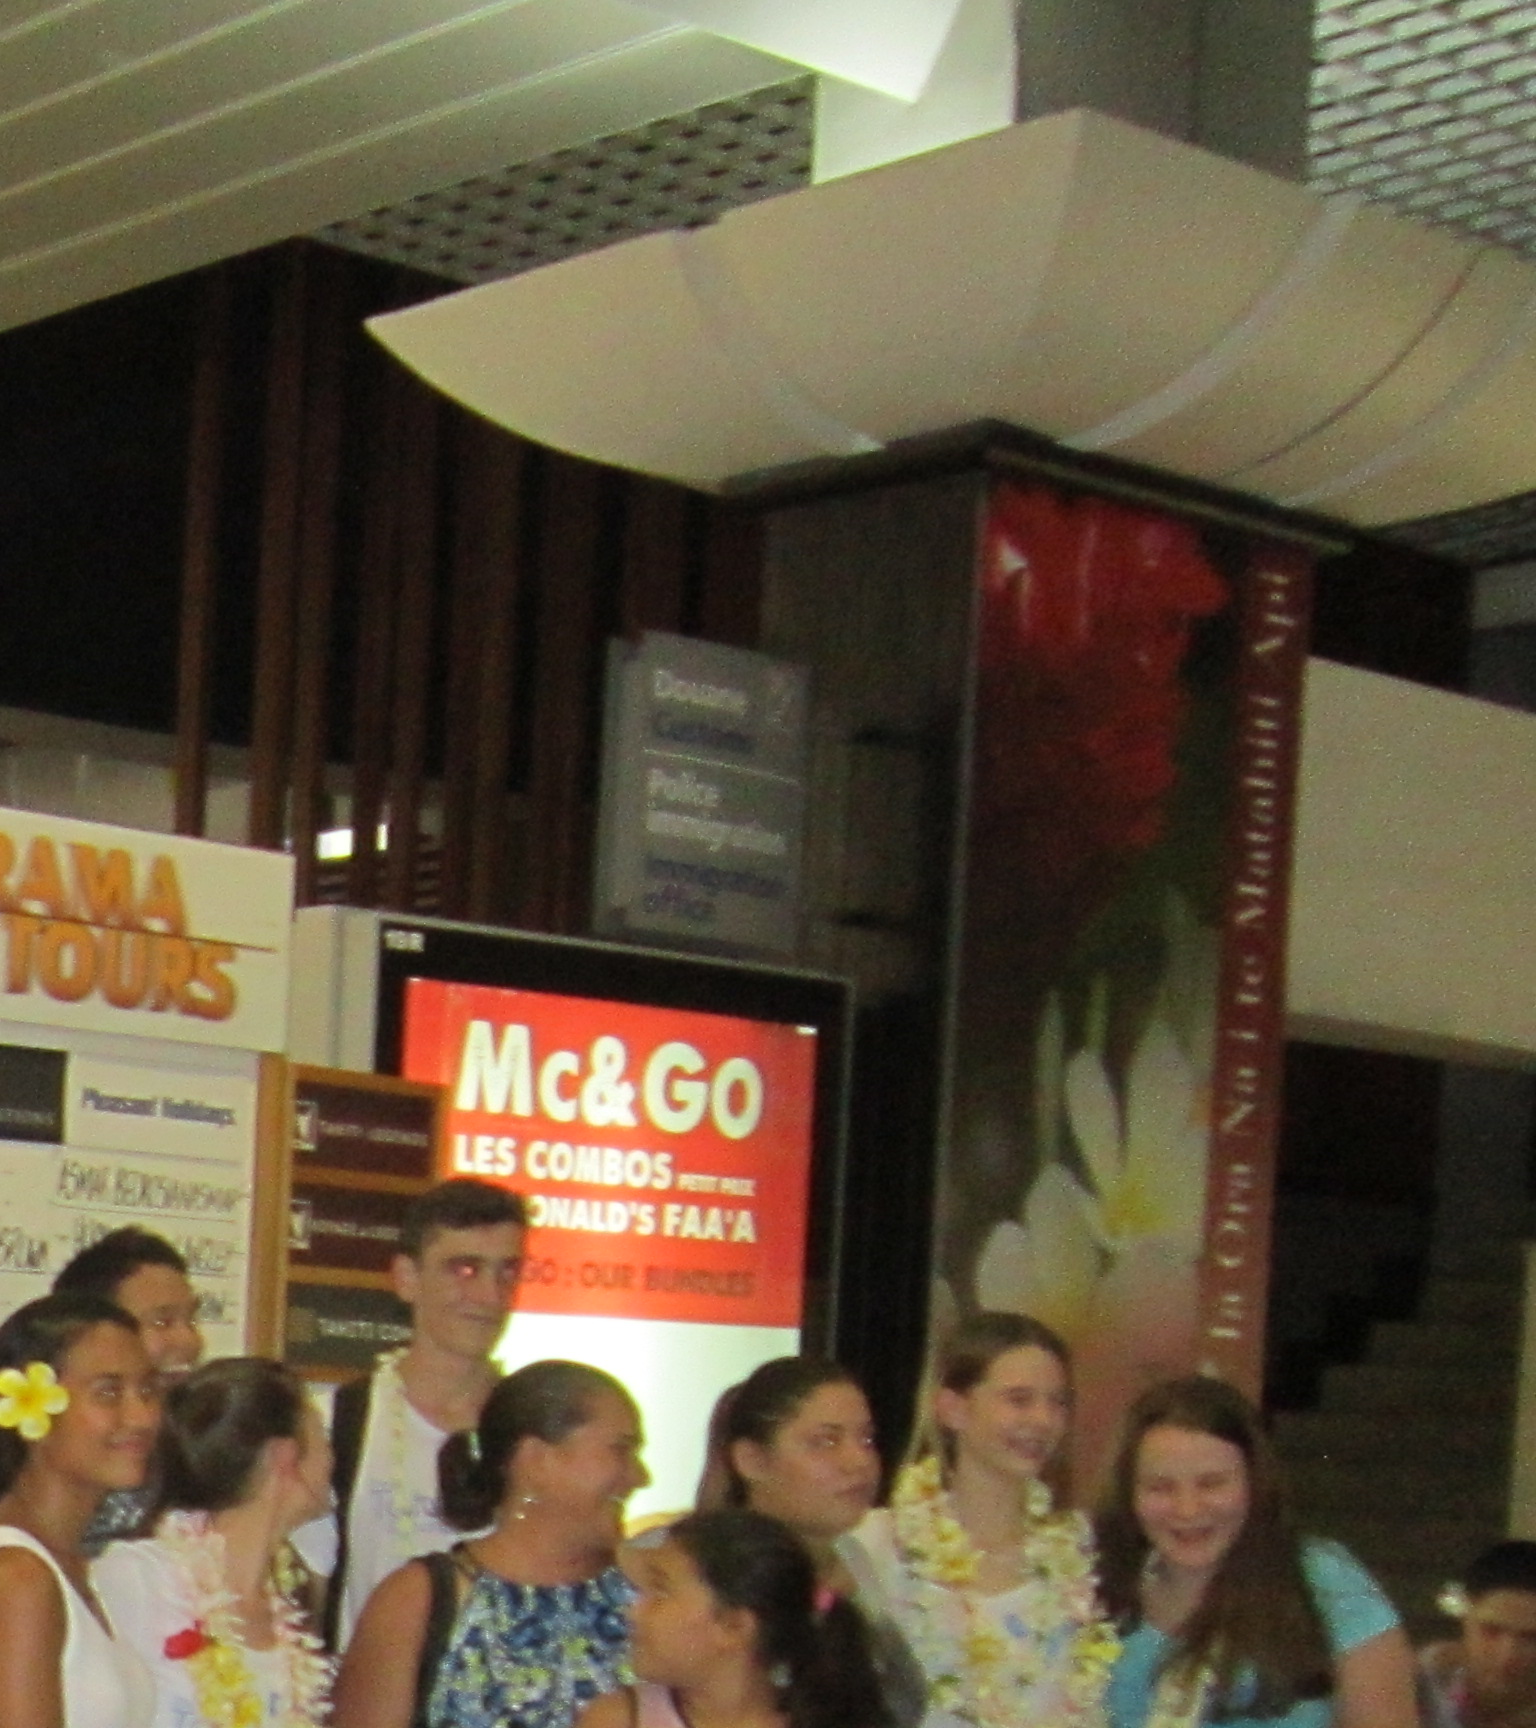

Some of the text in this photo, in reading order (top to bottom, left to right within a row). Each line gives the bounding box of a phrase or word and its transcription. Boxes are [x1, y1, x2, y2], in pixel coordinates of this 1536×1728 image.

[0, 911, 238, 1021] TOURS
[452, 1133, 517, 1177] LES
[525, 1140, 674, 1191] COMBOS
[529, 1195, 757, 1244] ONALD'S FAA'A
